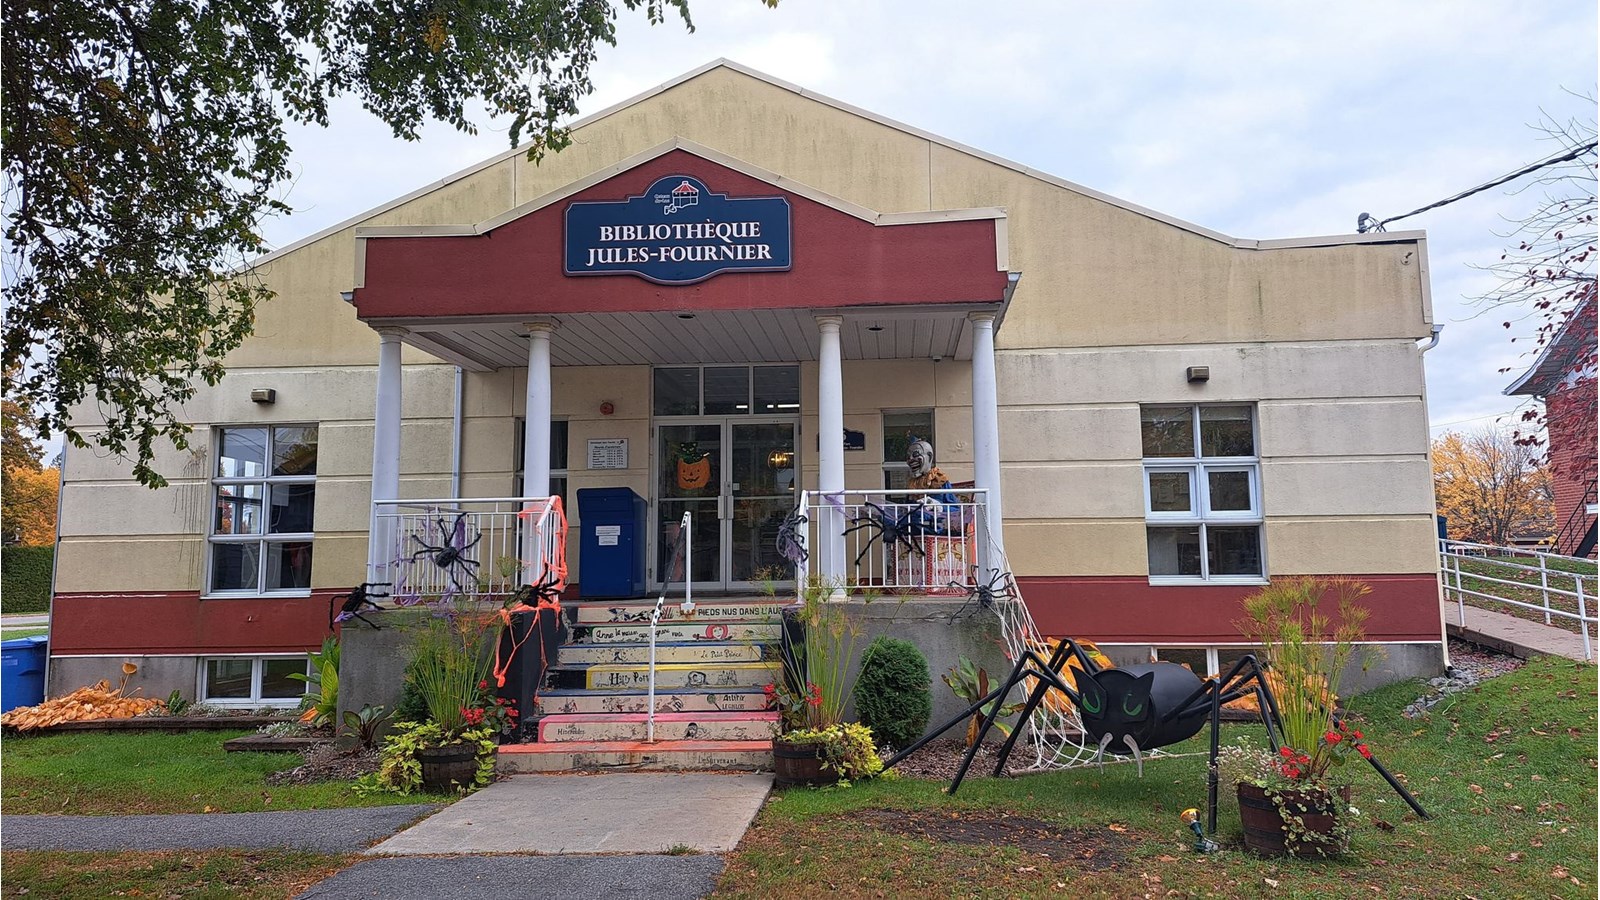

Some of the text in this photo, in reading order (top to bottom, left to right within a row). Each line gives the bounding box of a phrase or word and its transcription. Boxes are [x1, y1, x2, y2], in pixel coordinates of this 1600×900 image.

[599, 218, 761, 243] BIBLIOTHÈQUE
[585, 244, 772, 267] JULES-FOURNIER
[698, 608, 720, 616] PIEDS
[722, 607, 738, 616] NUS
[740, 607, 760, 615] DANS
[595, 630, 614, 639] Anne
[633, 671, 649, 683] Pott
